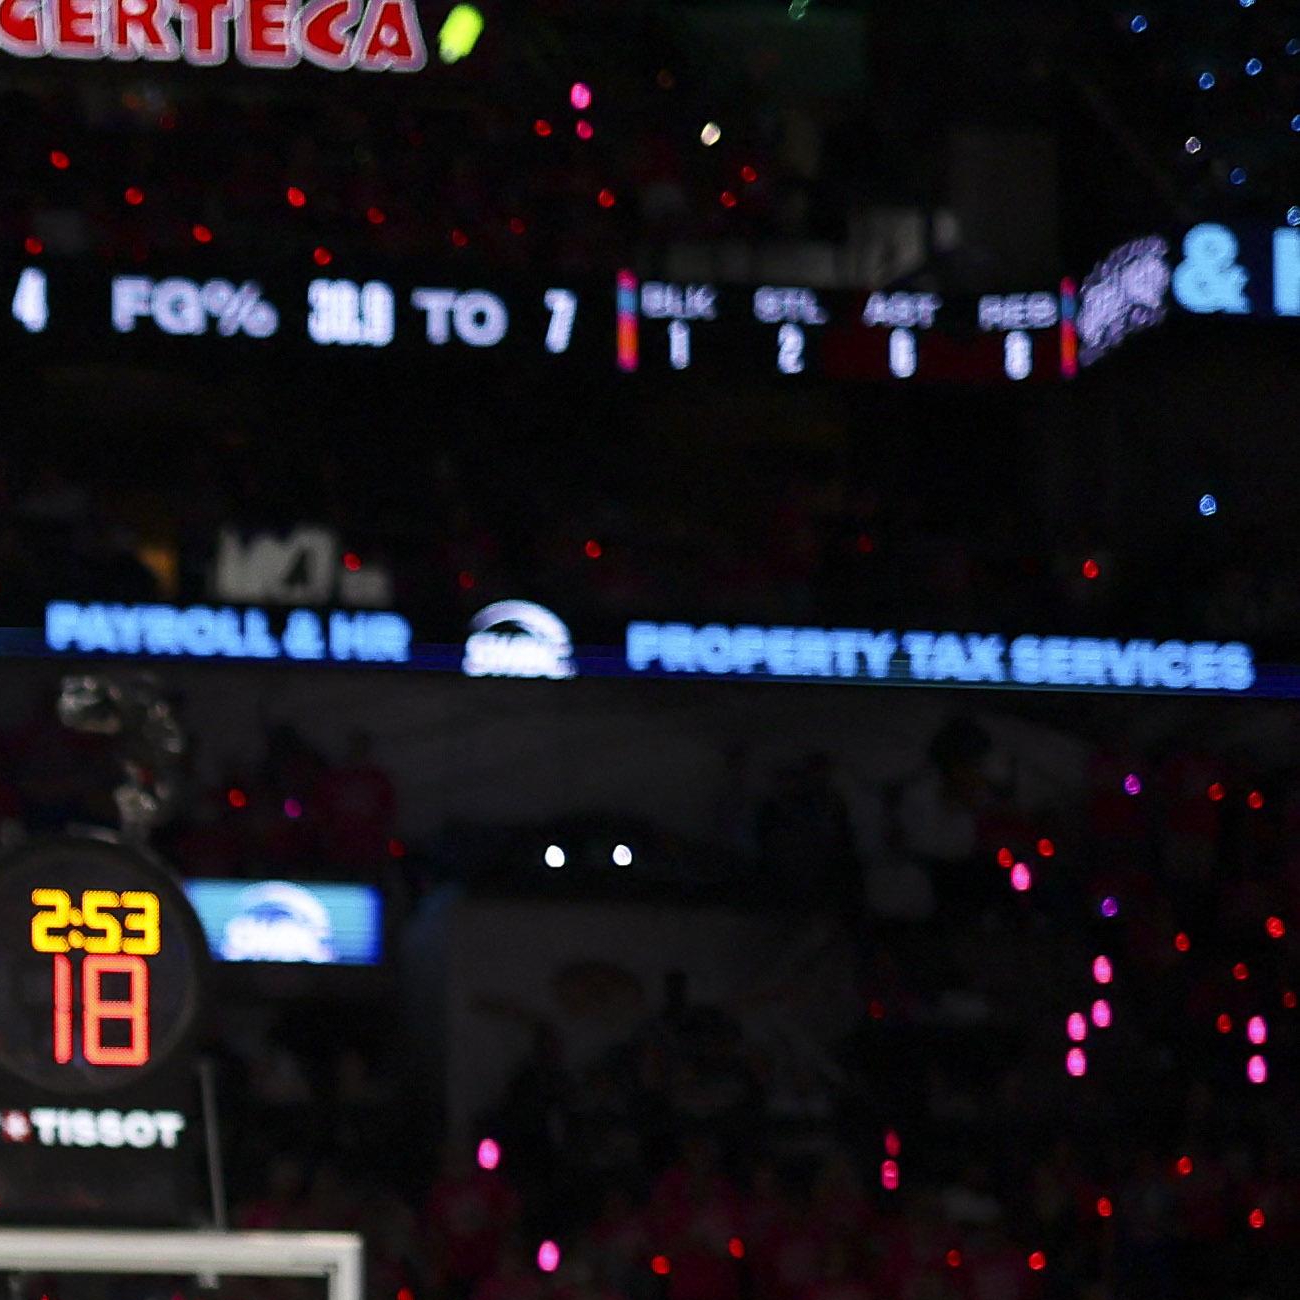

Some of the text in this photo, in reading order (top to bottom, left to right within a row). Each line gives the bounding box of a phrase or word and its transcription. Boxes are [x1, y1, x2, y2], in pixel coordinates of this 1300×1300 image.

[112, 276, 278, 338] FG%
[412, 288, 508, 346] TO
[544, 289, 577, 353] 7
[45, 601, 280, 659] PAYROLL
[283, 609, 325, 661] &
[626, 621, 897, 679] PROPERTY
[902, 631, 1005, 683] TAX
[1009, 635, 1255, 691] SERVICES
[31, 888, 161, 955] 2:53
[53, 953, 151, 1067] 18
[30, 1108, 185, 1148] TISSOT
